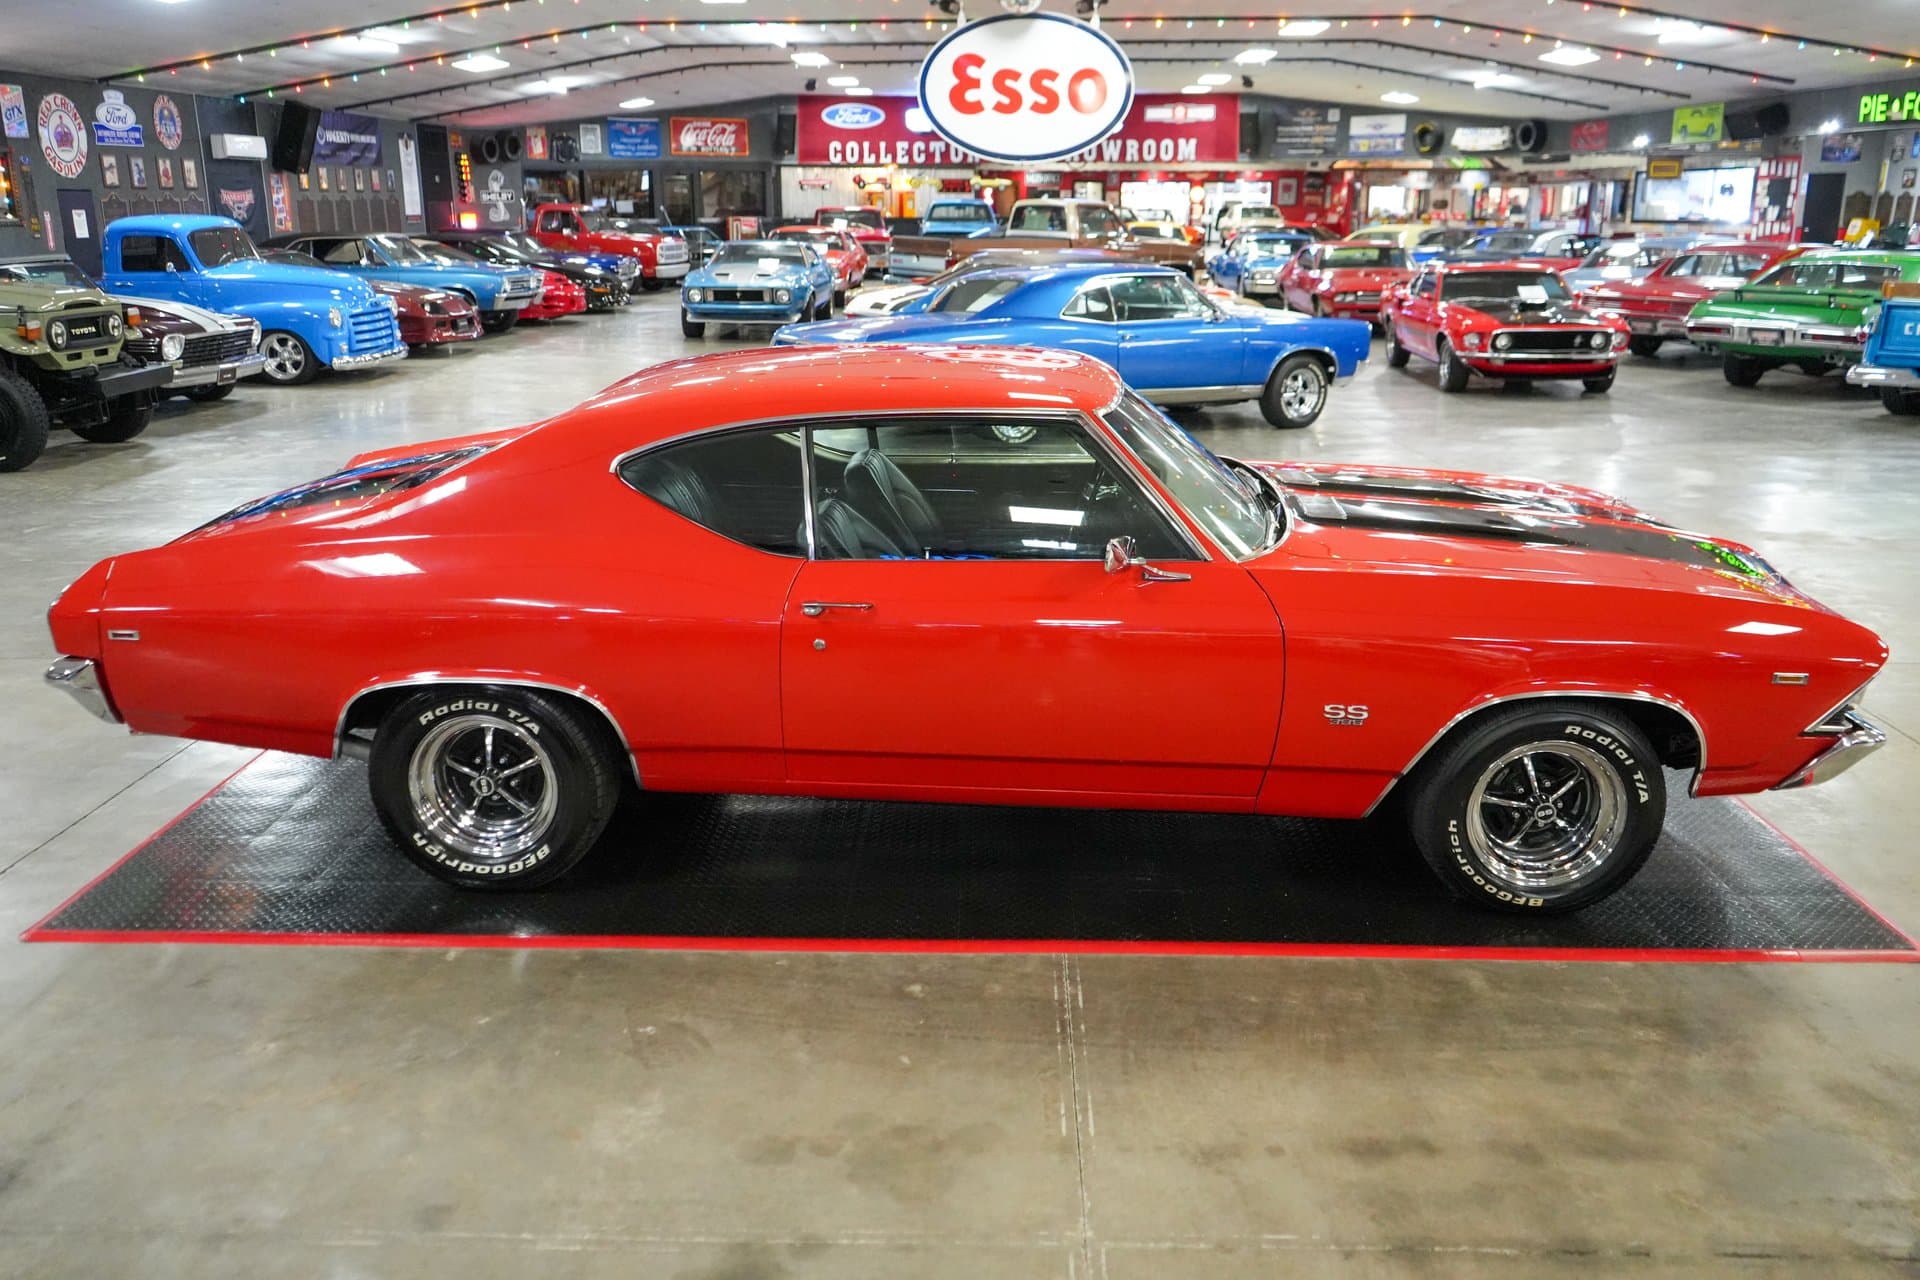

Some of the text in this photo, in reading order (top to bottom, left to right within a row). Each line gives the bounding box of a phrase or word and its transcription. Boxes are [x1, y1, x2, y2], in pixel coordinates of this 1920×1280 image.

[40, 95, 84, 131] RED CROWN
[104, 106, 128, 125] Ford
[834, 105, 872, 126] Ford
[1858, 93, 1889, 123] PIE
[680, 122, 738, 148] Coca-Cola
[44, 146, 88, 177] GASOLINE
[70, 325, 97, 336] TOYOTA
[418, 699, 541, 736] Radial T/A
[1323, 704, 1369, 719] SS
[1565, 724, 1649, 804] Radial T/A
[412, 832, 551, 875] BFGoodrich
[1448, 819, 1545, 908] BFGoodrich
